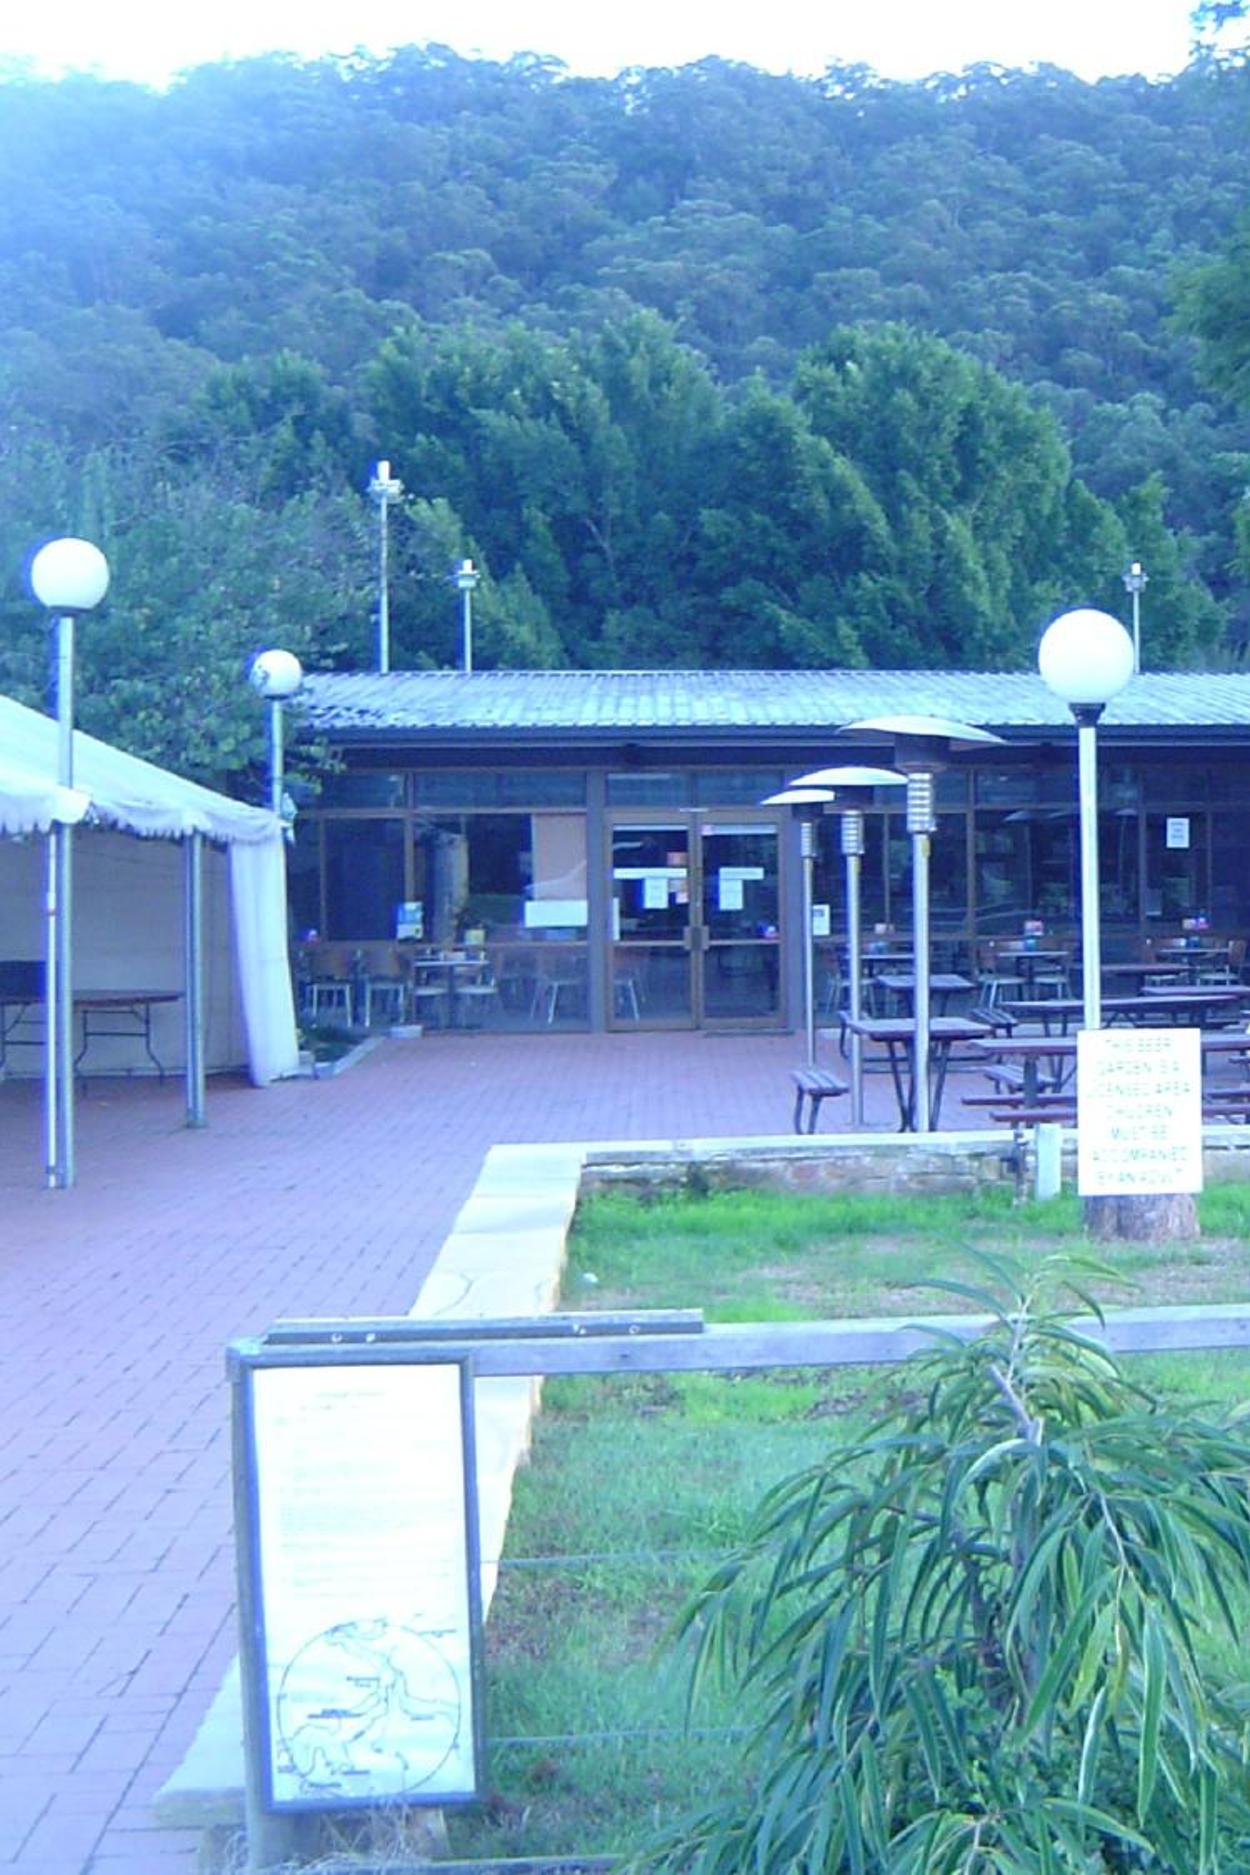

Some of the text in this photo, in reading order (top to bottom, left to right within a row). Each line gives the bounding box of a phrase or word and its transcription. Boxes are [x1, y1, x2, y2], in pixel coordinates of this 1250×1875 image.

[1137, 1037, 1172, 1052] BEER
[1097, 1060, 1153, 1076] GARDEN
[1154, 1081, 1191, 1096] AREA
[1150, 1125, 1168, 1140] BE
